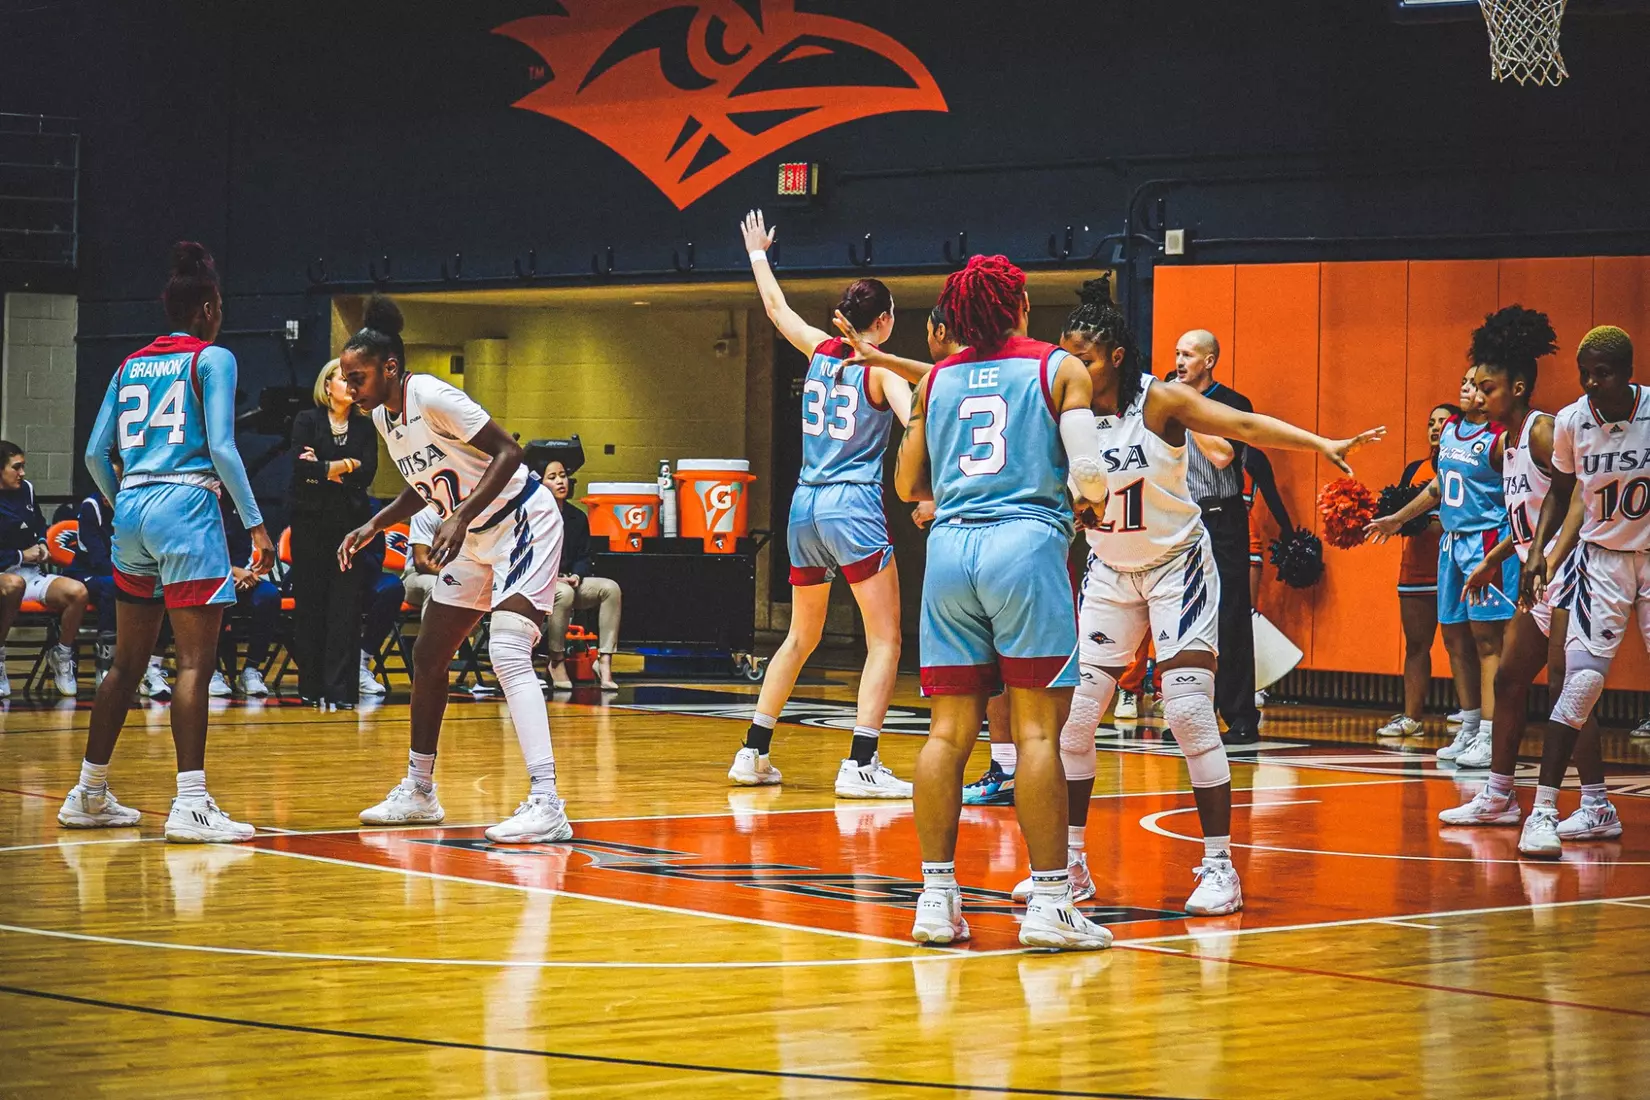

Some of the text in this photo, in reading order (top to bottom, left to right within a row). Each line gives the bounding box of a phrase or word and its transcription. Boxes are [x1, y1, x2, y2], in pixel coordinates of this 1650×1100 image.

[129, 360, 184, 379] BRANNON
[968, 366, 1000, 389] LEE
[118, 379, 187, 450] 24
[802, 379, 859, 441] 33
[958, 393, 1008, 477] 3
[397, 443, 448, 478] UTSA
[1099, 444, 1150, 473] SA
[1503, 473, 1533, 497] TSA
[1594, 476, 1650, 522] 10
